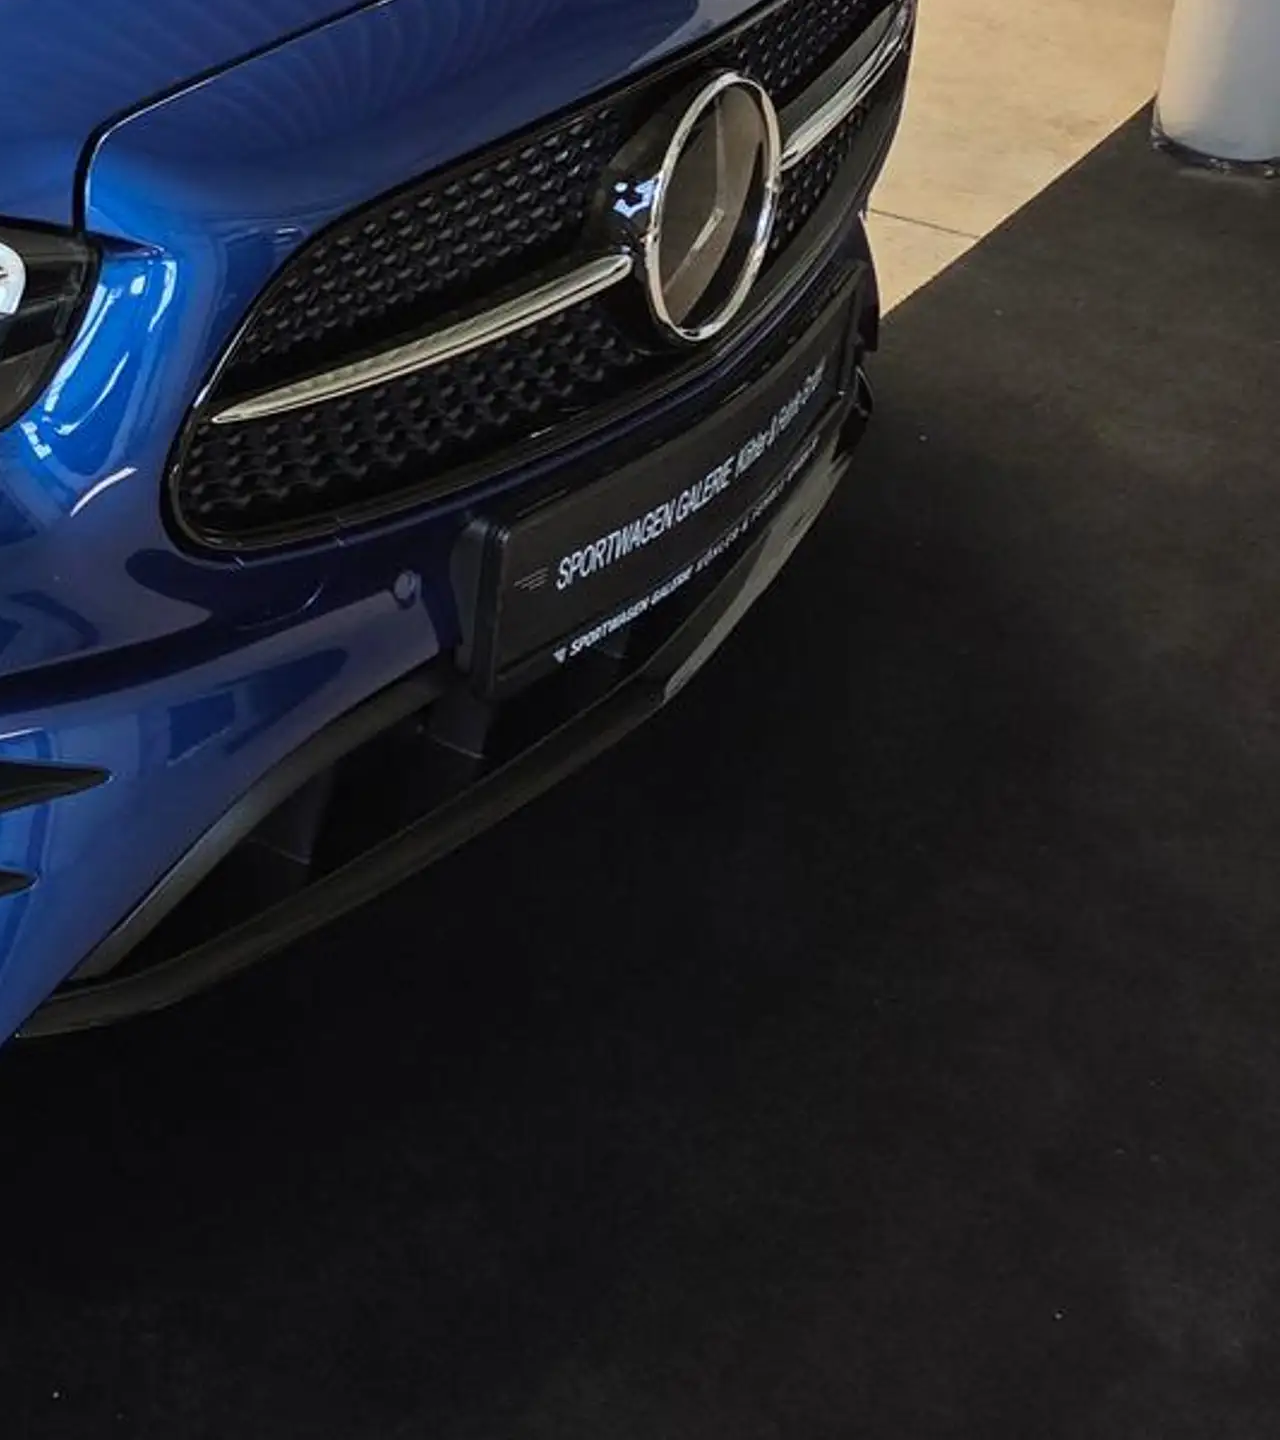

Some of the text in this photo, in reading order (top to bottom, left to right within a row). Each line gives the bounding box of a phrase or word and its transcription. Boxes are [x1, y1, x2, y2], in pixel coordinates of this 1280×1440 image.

[555, 498, 677, 590] SPORTWAGEN
[675, 455, 736, 523] GALERIE
[569, 596, 650, 657] SPORTWAGEN
